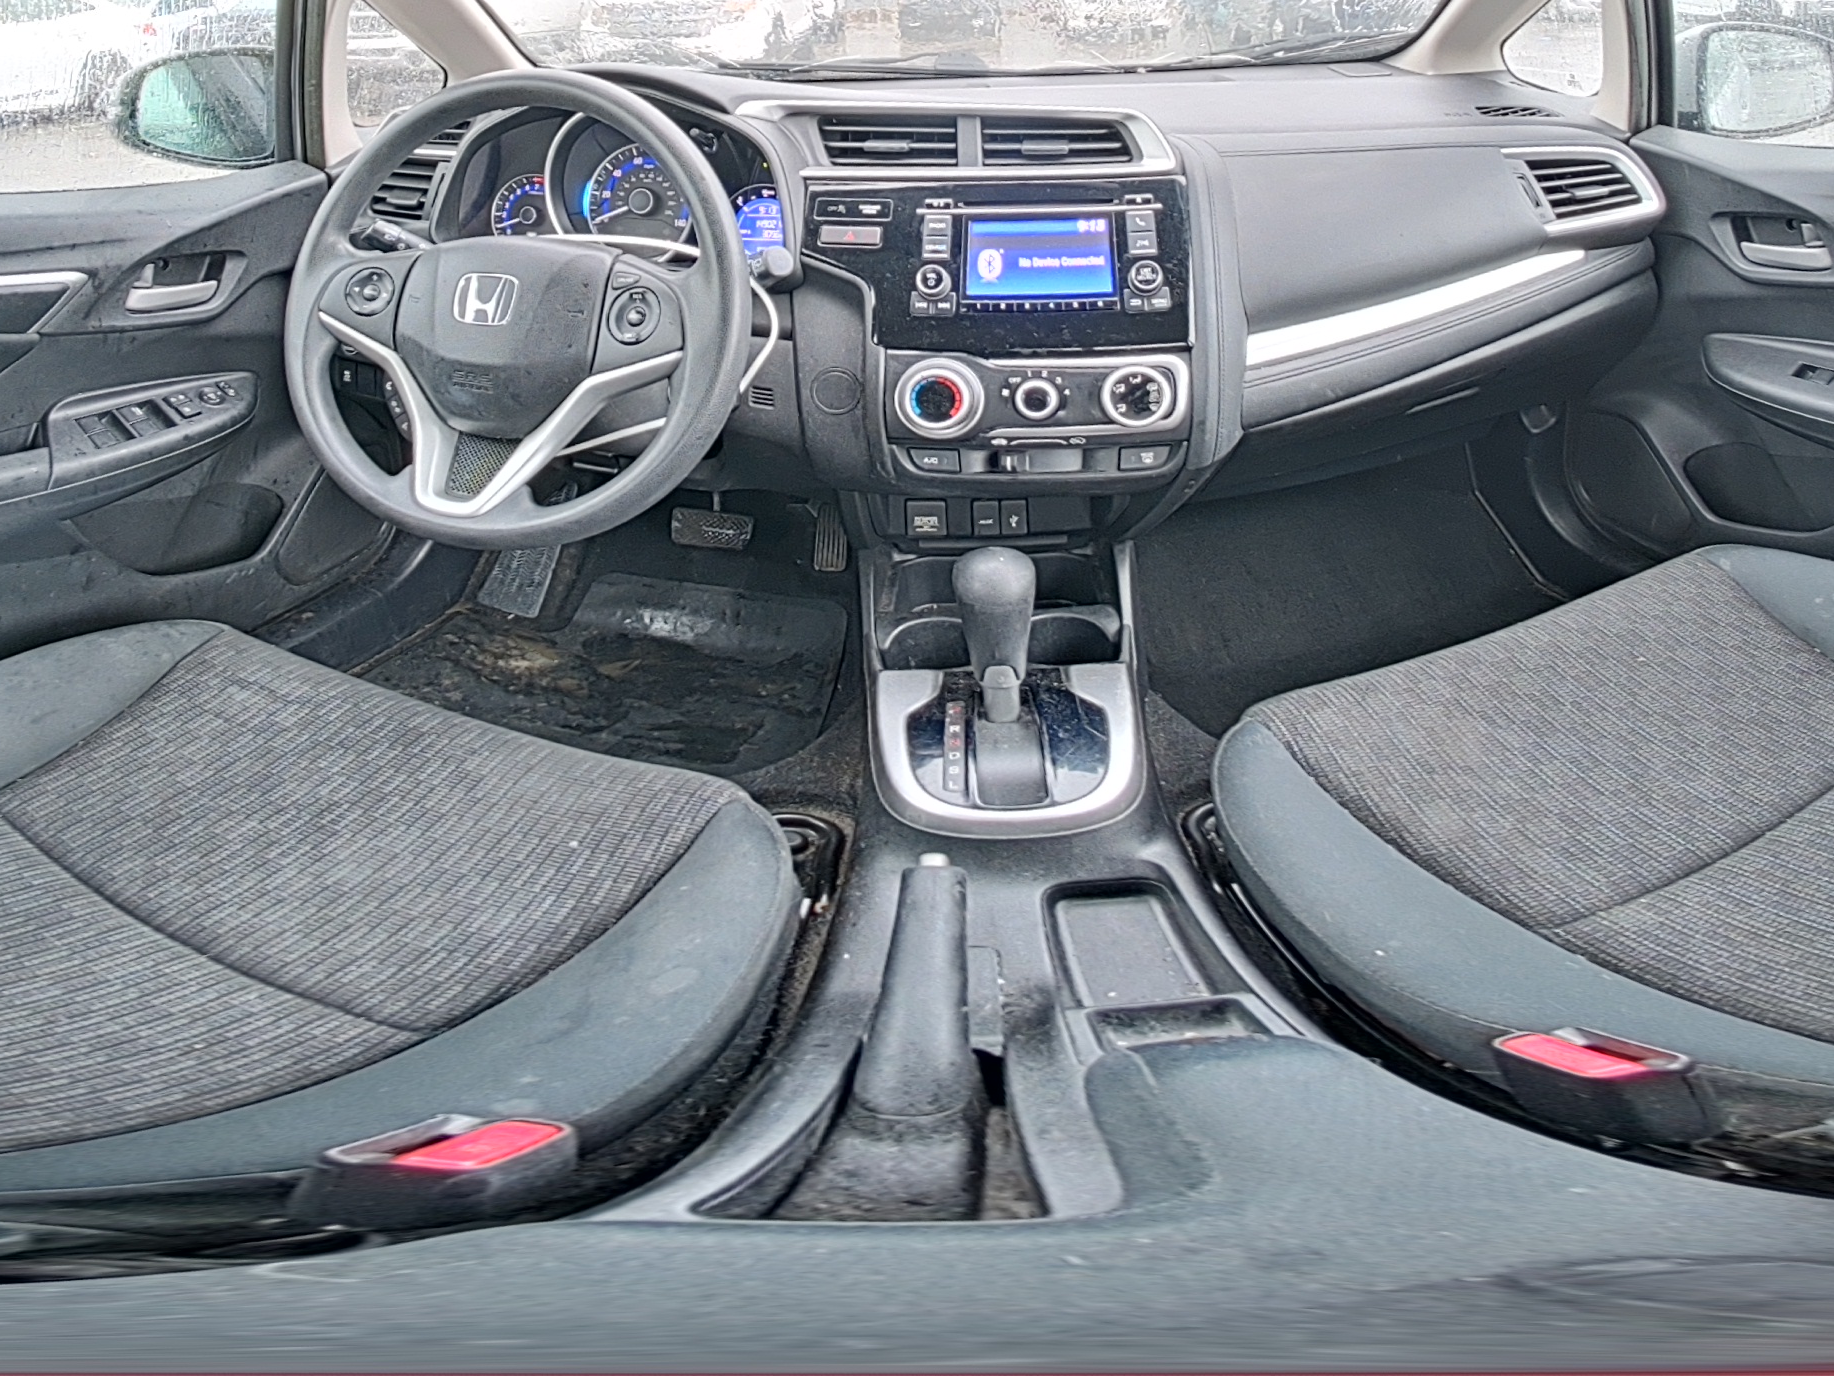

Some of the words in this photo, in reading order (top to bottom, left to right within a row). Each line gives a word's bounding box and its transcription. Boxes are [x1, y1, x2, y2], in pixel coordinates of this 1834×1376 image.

[1019, 257, 1031, 267] No
[1032, 256, 1060, 267] Device
[1061, 255, 1105, 267] Connected
[950, 725, 960, 734] R
[949, 752, 960, 760] D
[949, 766, 959, 774] S
[949, 780, 958, 789] L
